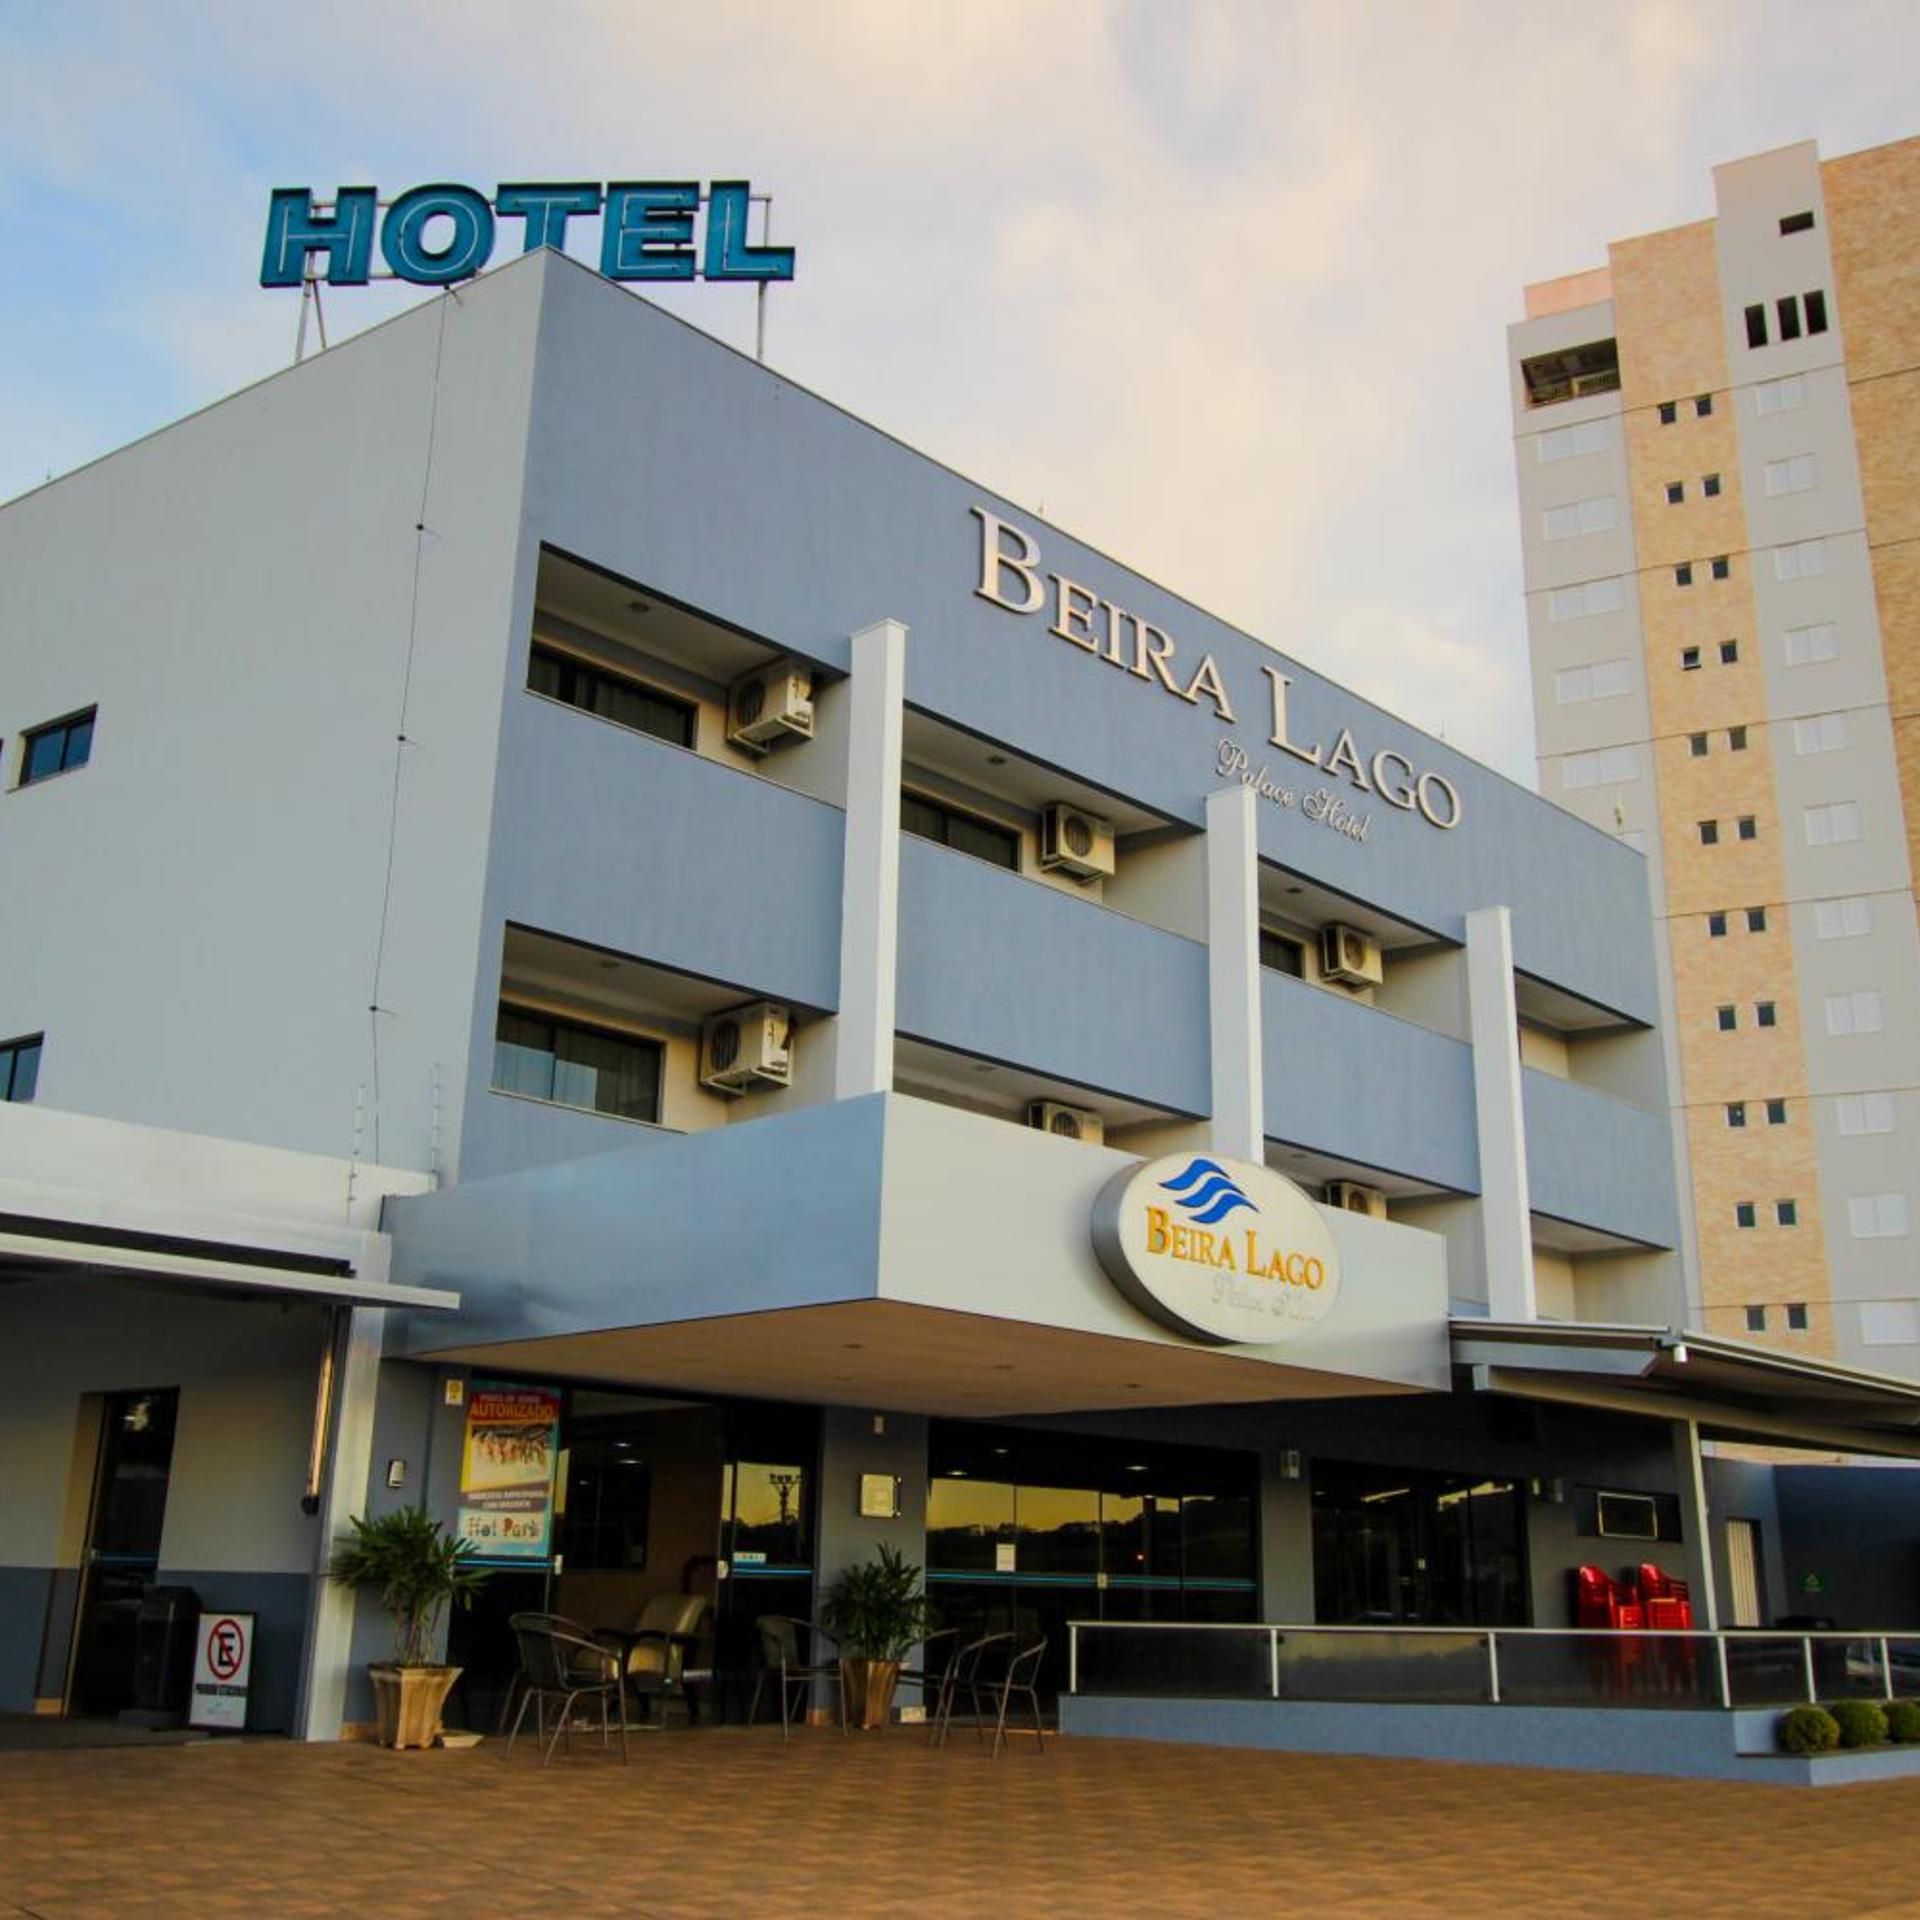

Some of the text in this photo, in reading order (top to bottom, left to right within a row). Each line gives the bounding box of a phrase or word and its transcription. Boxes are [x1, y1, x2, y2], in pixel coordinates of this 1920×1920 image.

[260, 180, 795, 288] HOTEL
[969, 506, 1463, 831] BEIRA LAGO
[1216, 738, 1371, 841] Palace Hotel
[1146, 1205, 1325, 1290] BEIRA LAGO
[470, 1402, 555, 1418] AUTORIZADO
